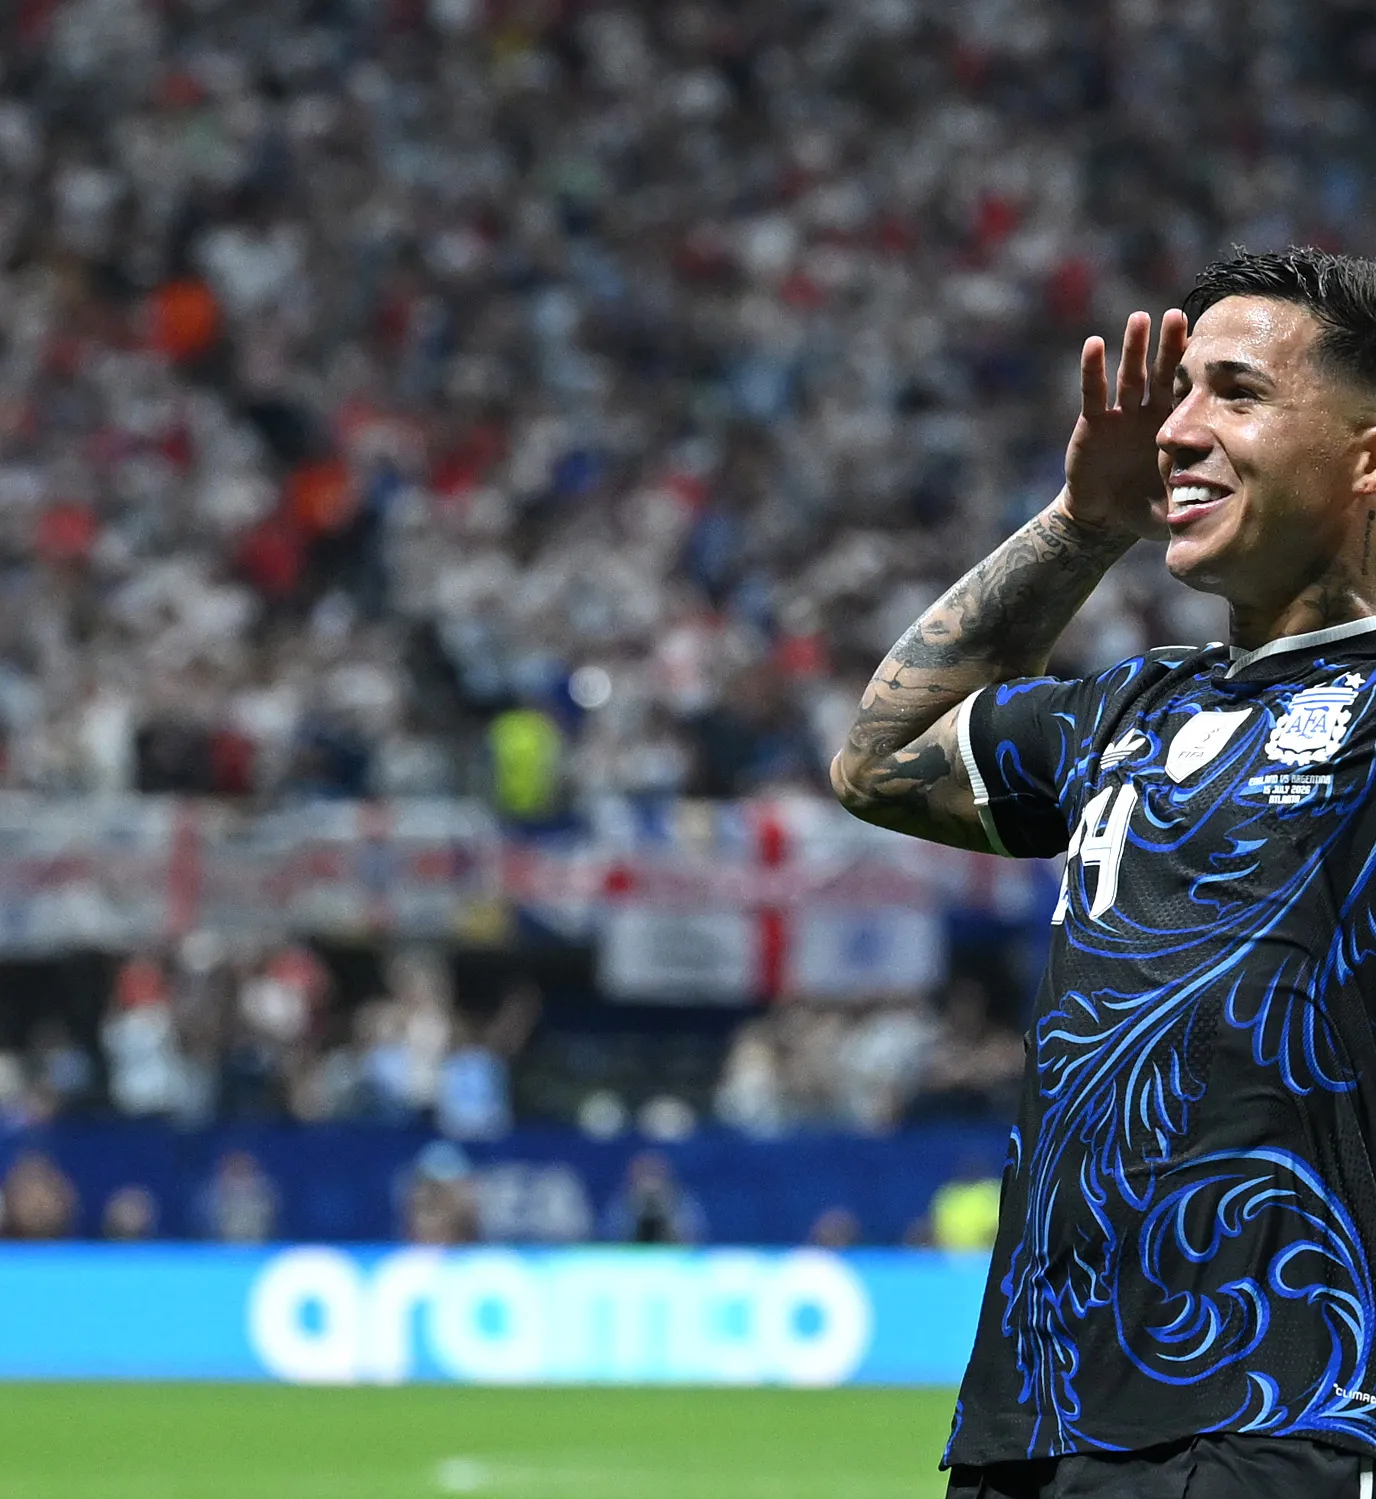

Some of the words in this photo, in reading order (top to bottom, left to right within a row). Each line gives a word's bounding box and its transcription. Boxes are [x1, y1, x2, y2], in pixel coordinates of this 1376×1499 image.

[1285, 705, 1330, 740] AFA
[1177, 750, 1205, 759] FIFA
[1280, 774, 1290, 784] VS
[1291, 774, 1331, 785] ARGENTINA
[1263, 785, 1271, 795] 15
[1271, 785, 1290, 795] JULY
[1291, 785, 1311, 795] 2026
[247, 1246, 874, 1389] aramco
